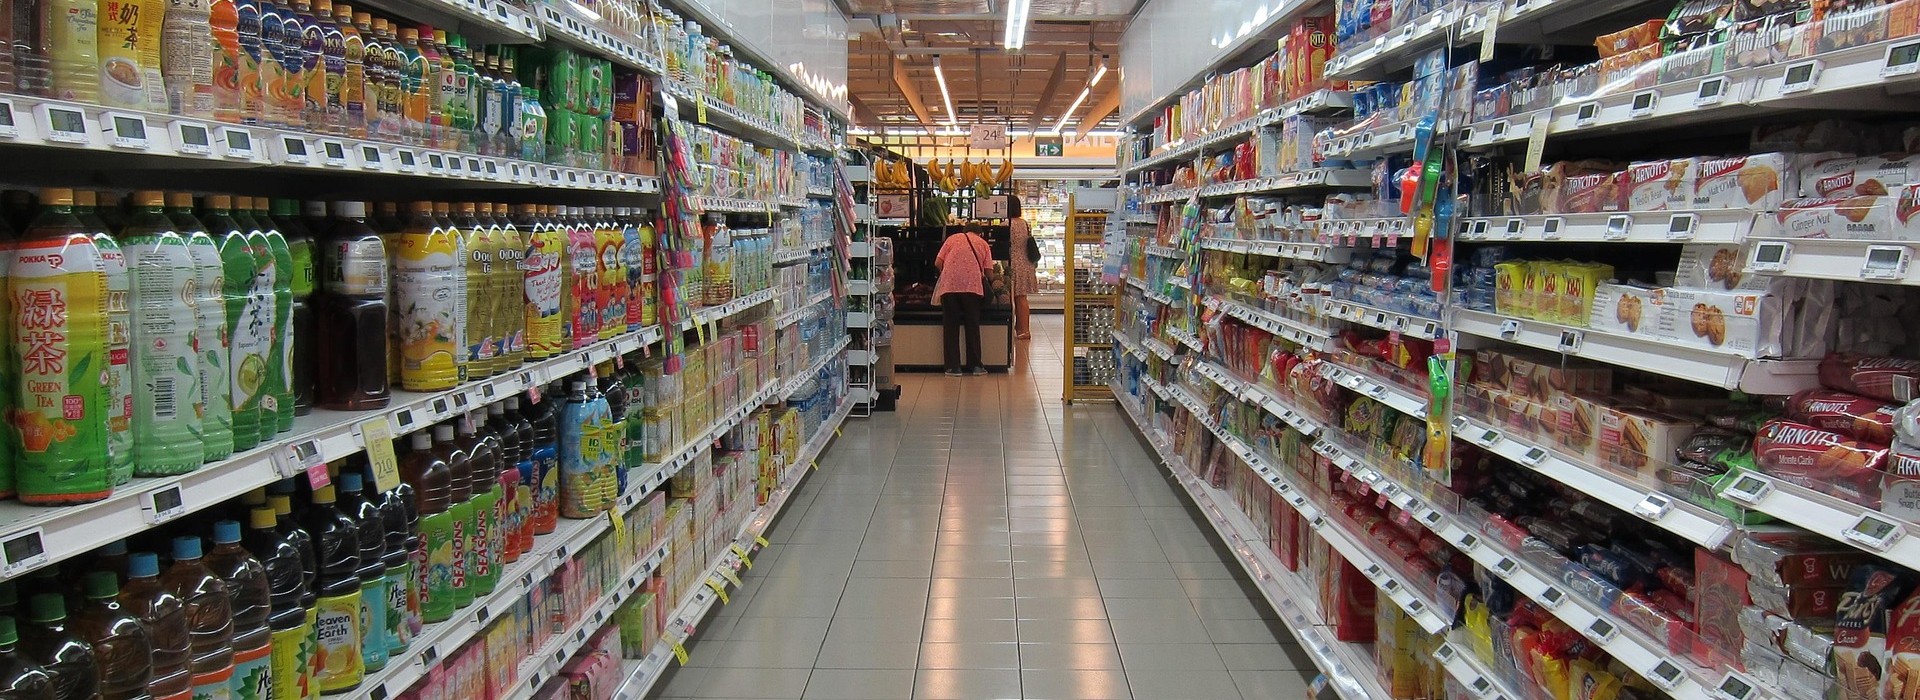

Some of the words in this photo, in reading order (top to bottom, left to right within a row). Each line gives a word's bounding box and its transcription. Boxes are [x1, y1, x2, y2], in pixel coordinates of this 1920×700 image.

[1310, 33, 1326, 46] RITZ
[365, 47, 384, 56] POK
[1823, 161, 1848, 174] Ginger
[1791, 217, 1815, 232] Ginger
[1817, 213, 1831, 225] Nut
[19, 254, 46, 264] POKKA
[1779, 454, 1797, 465] Monte
[1798, 455, 1814, 466] Carlo
[477, 509, 490, 577] SEASONS
[452, 520, 466, 589] SEASONS
[317, 625, 348, 641] Earth
